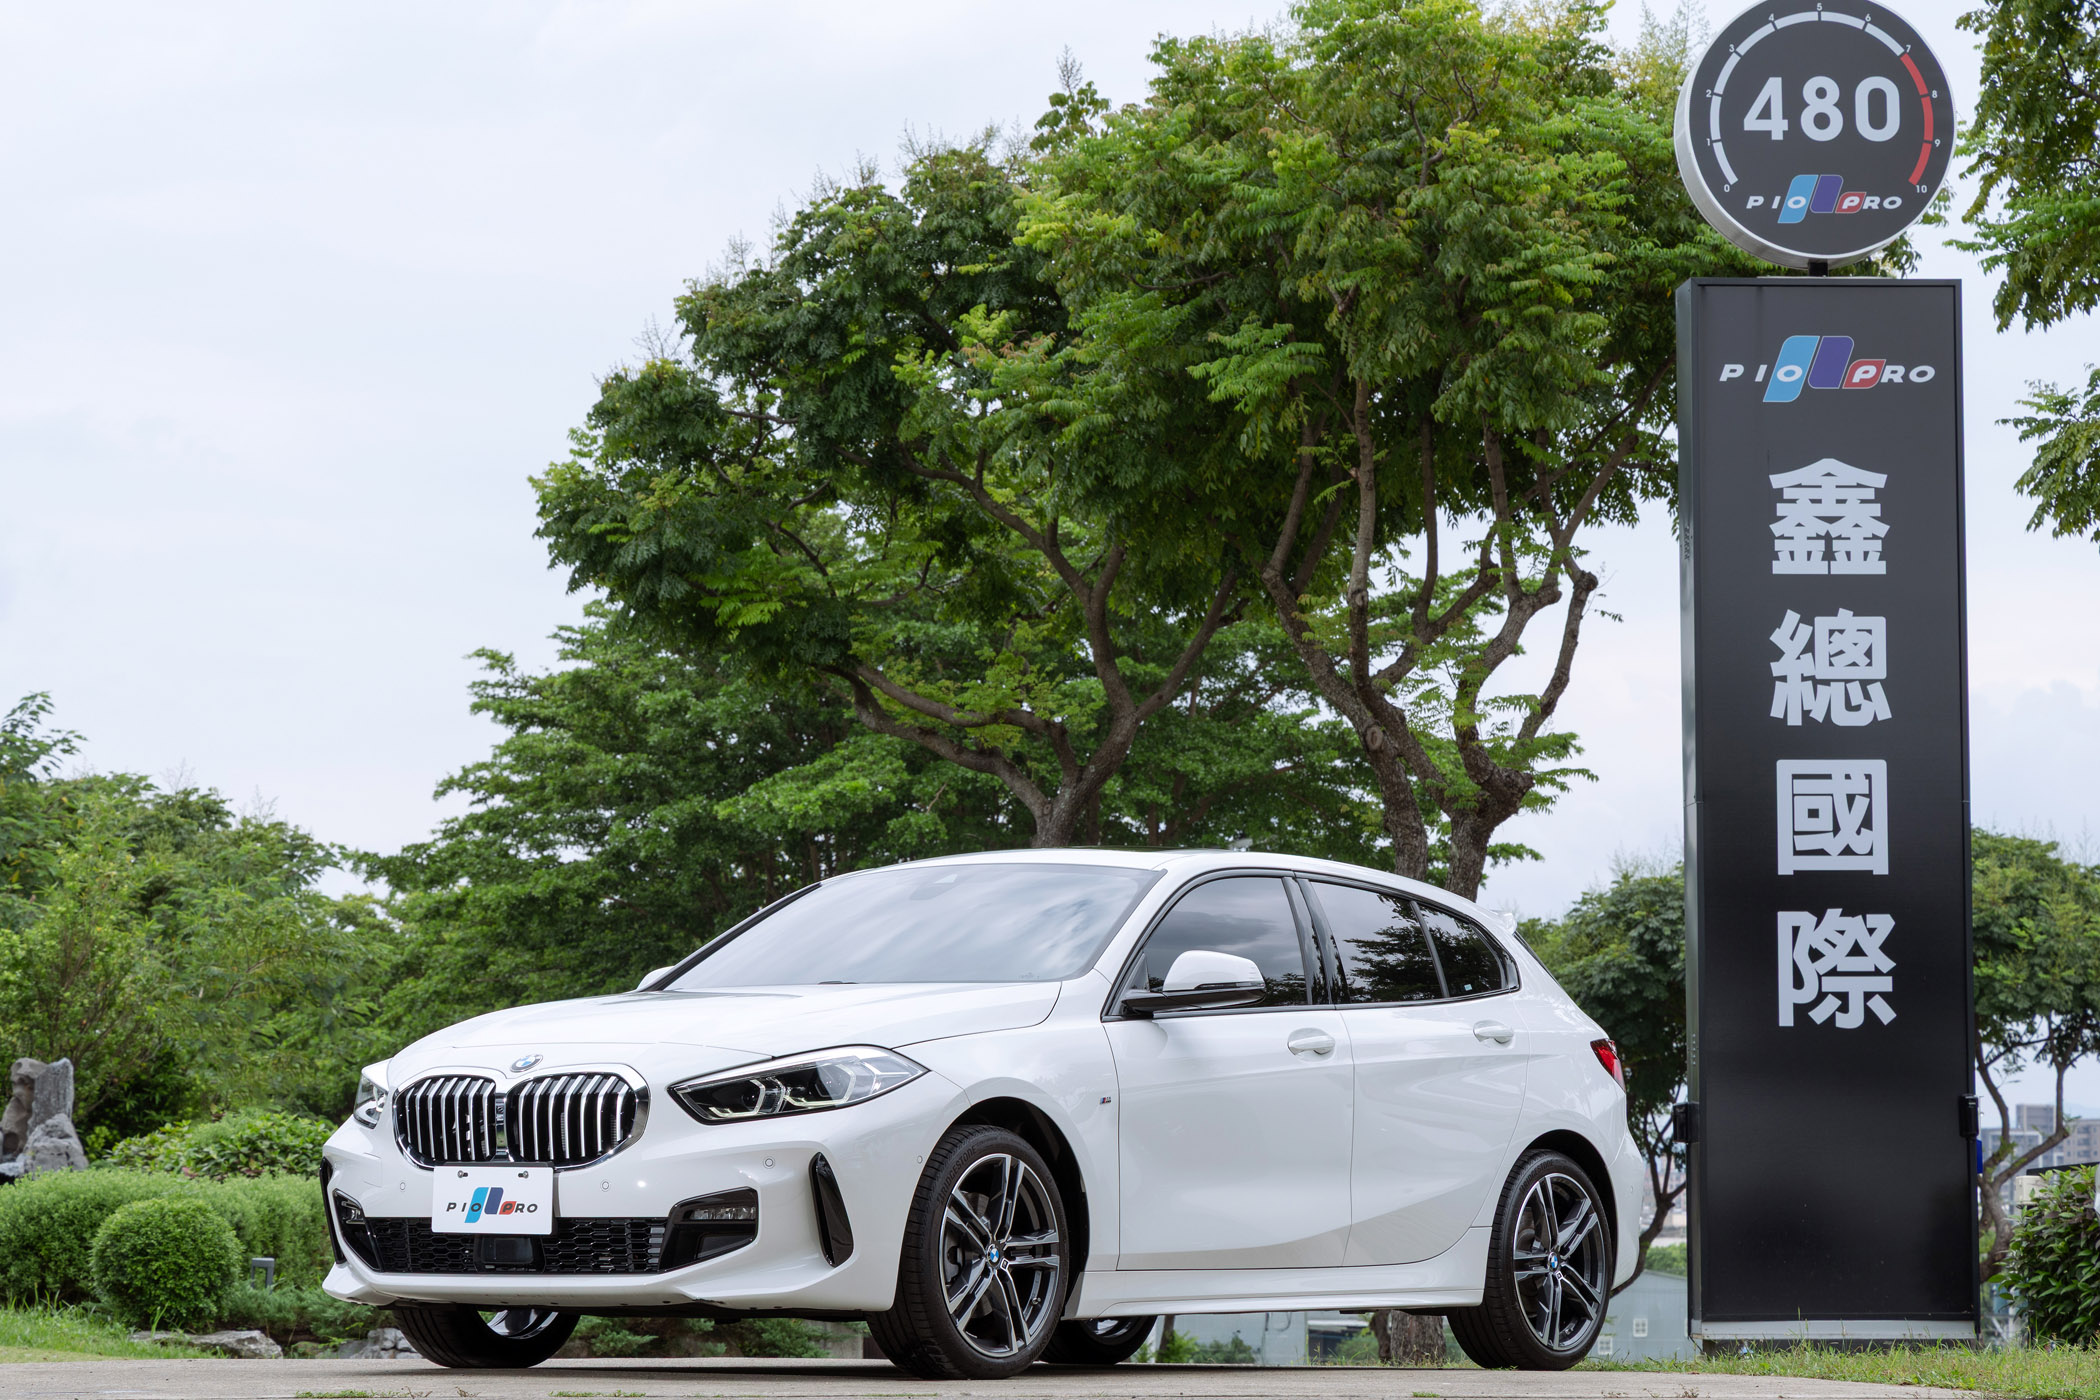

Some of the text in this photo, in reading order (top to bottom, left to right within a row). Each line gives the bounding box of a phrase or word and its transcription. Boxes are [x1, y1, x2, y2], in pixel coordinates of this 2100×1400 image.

[1705, 3, 1941, 194] 0 1 2 3 4 5 6 7 8 9 10
[1743, 75, 1901, 142] 480
[1746, 196, 1902, 209] PIO PRO
[1719, 364, 1936, 383] PIO PRO
[1768, 458, 1897, 1029] 鑫總國際
[937, 1145, 978, 1205] BRIDGESTONE
[446, 1202, 538, 1213] PIO PRO
